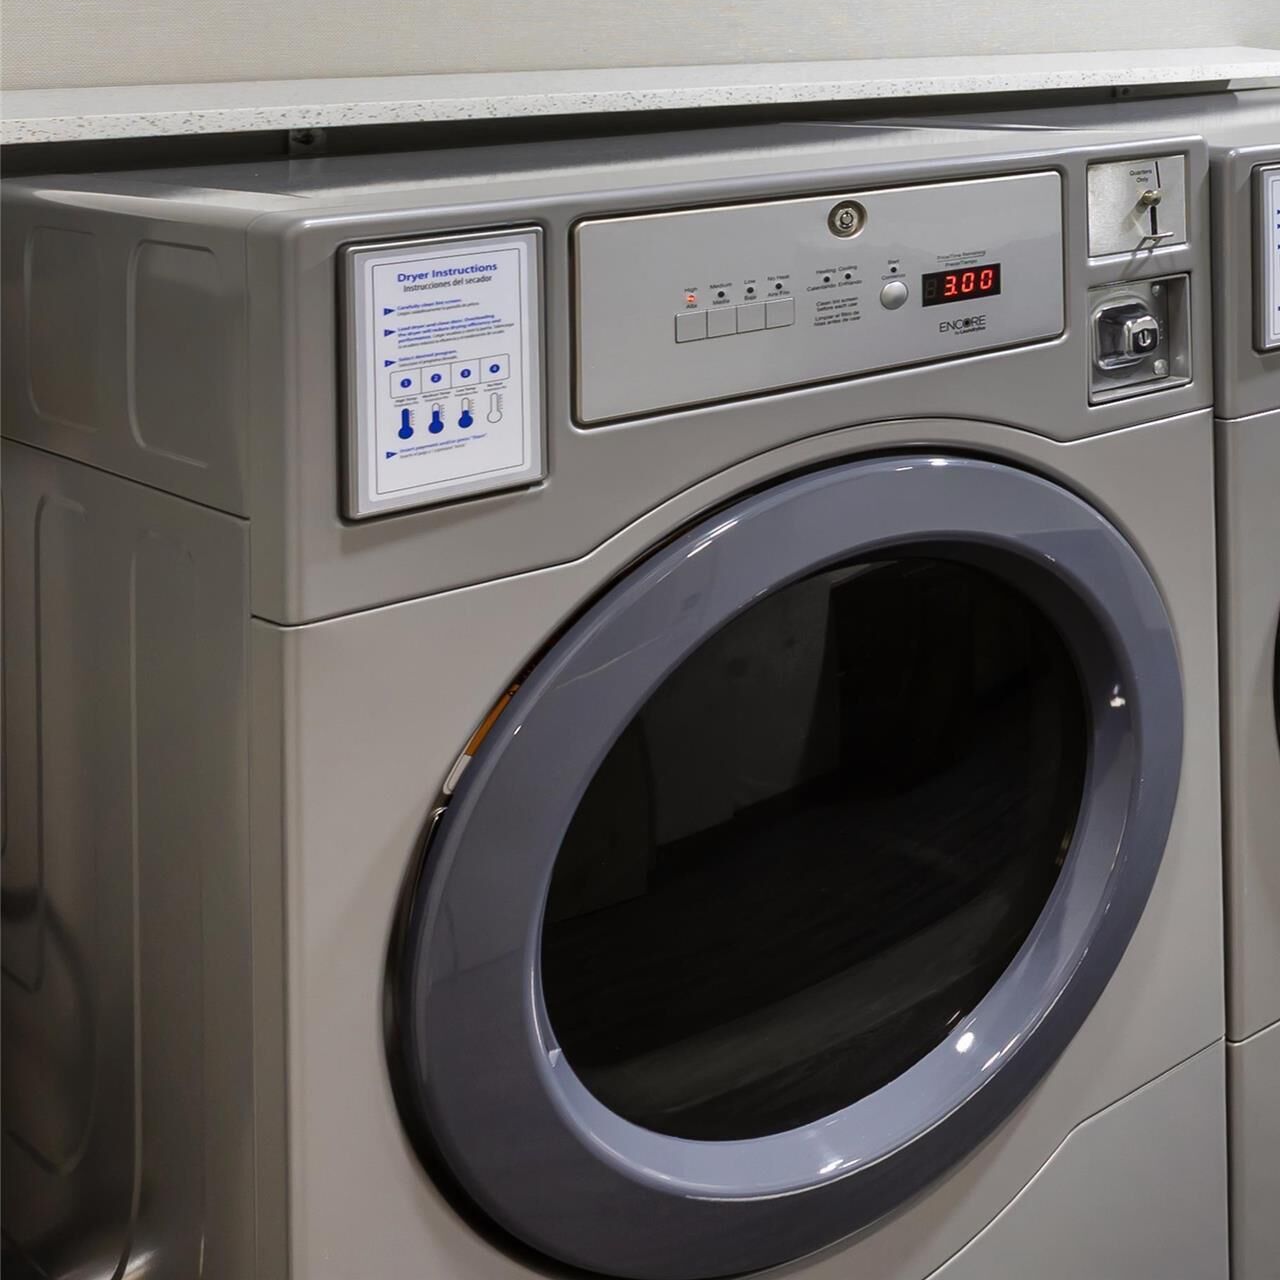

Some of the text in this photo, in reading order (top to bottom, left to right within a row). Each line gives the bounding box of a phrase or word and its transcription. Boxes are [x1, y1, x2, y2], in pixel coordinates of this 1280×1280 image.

[397, 263, 498, 284] Dryer Instructions
[403, 274, 493, 293] Instrucciones del secador
[944, 269, 993, 296] 3.00
[939, 315, 986, 333] ENCORE
